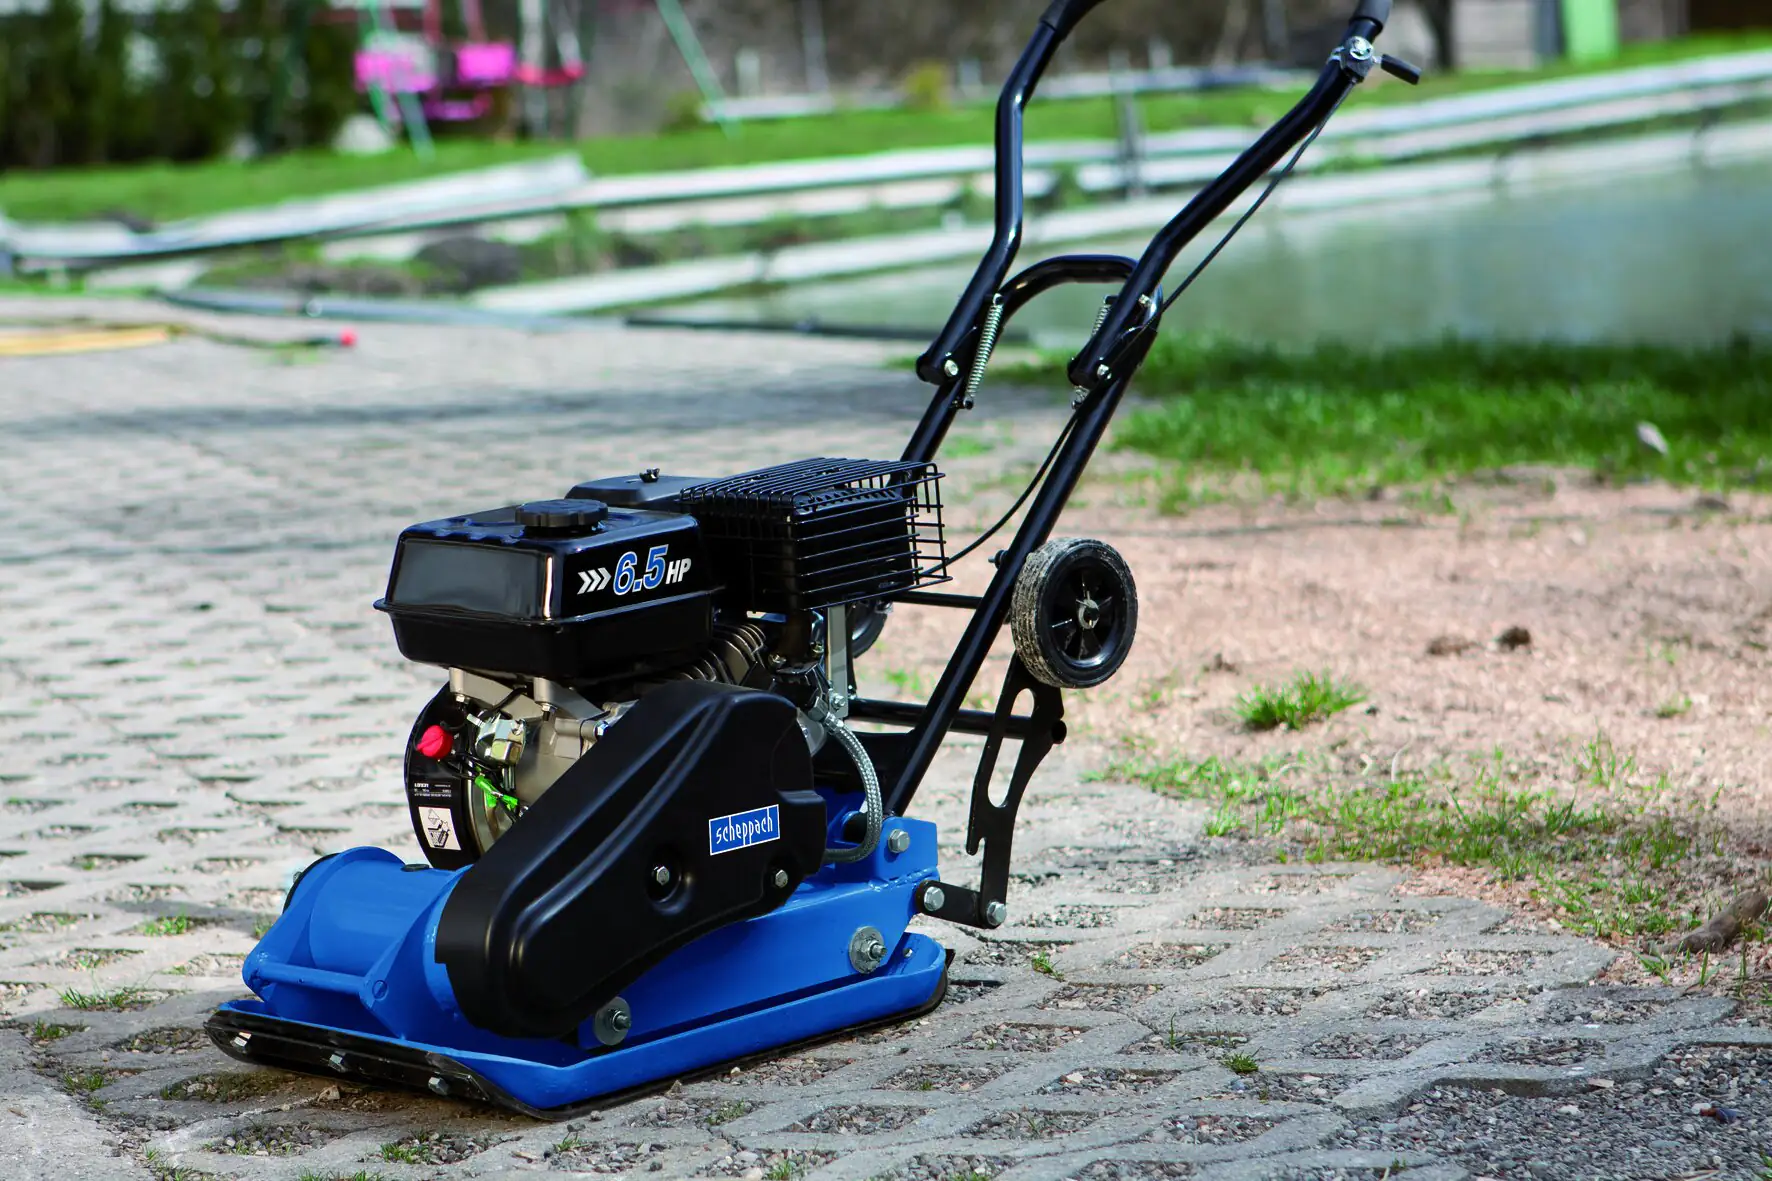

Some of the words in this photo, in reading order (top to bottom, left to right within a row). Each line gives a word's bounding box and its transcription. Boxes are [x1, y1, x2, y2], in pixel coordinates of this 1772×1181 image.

[613, 544, 669, 596] 6.5
[665, 557, 692, 585] HP
[715, 807, 773, 847] scheppach
